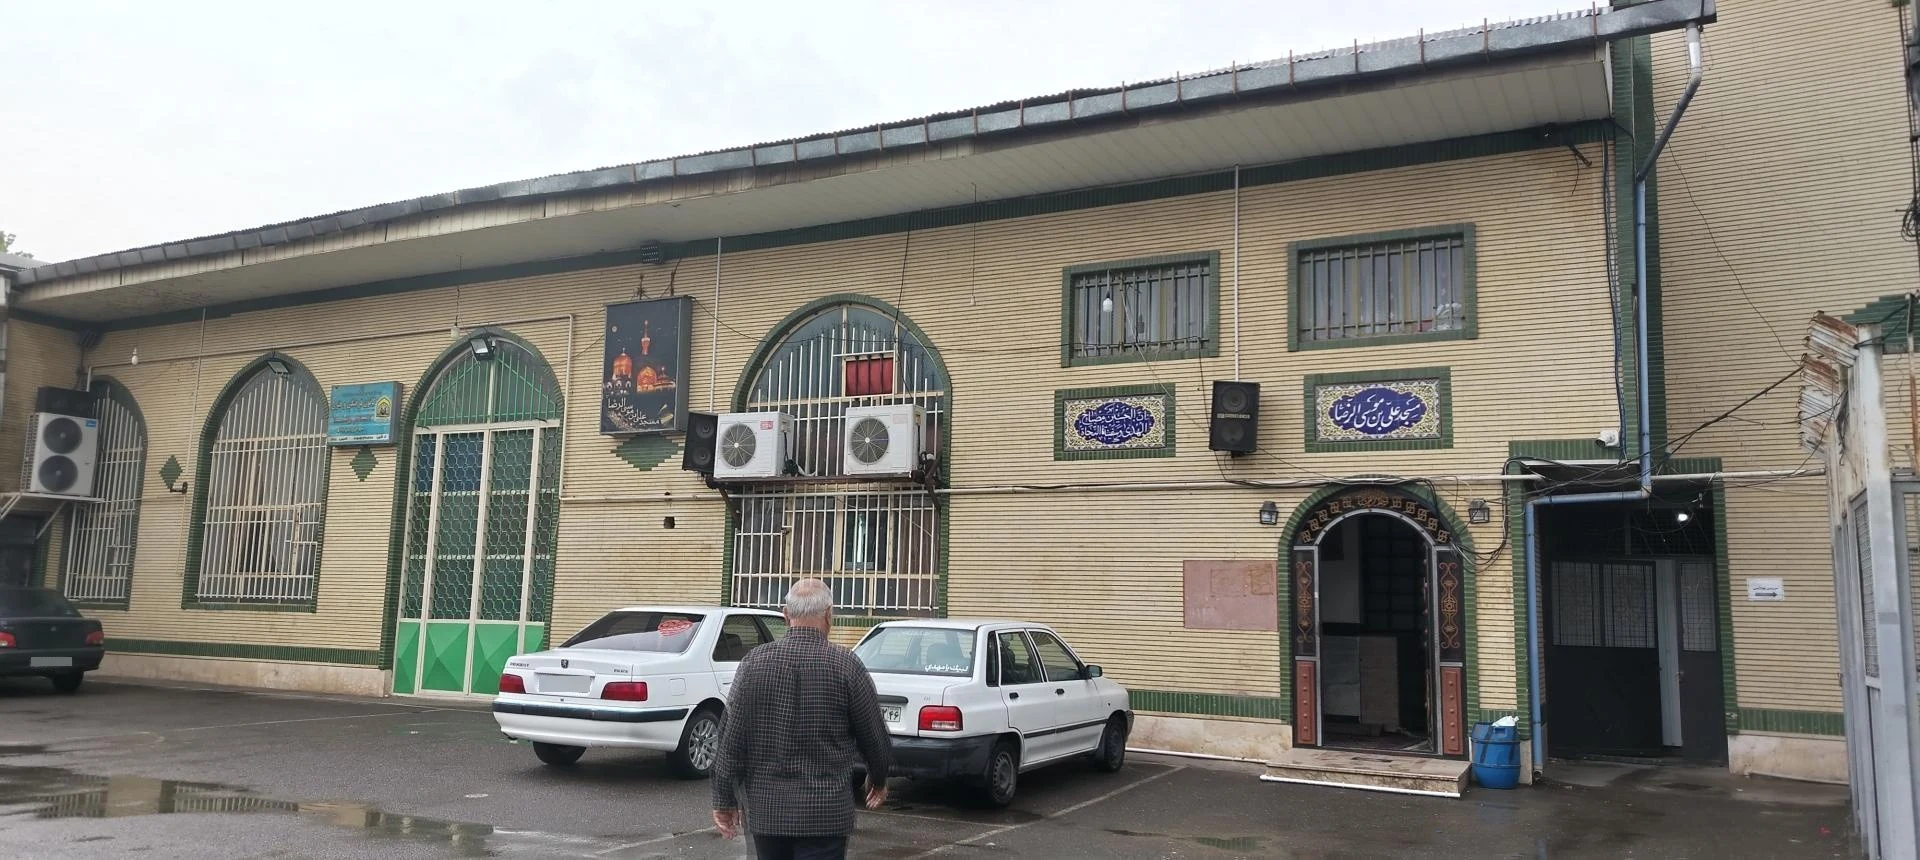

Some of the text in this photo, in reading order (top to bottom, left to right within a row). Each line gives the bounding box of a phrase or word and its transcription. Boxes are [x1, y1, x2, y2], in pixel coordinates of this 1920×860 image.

[607, 396, 626, 410] الرضا
[633, 411, 647, 423] علی
[1334, 396, 1421, 430] مسجد علی بن موسی الرضا
[639, 419, 660, 427] مسجد
